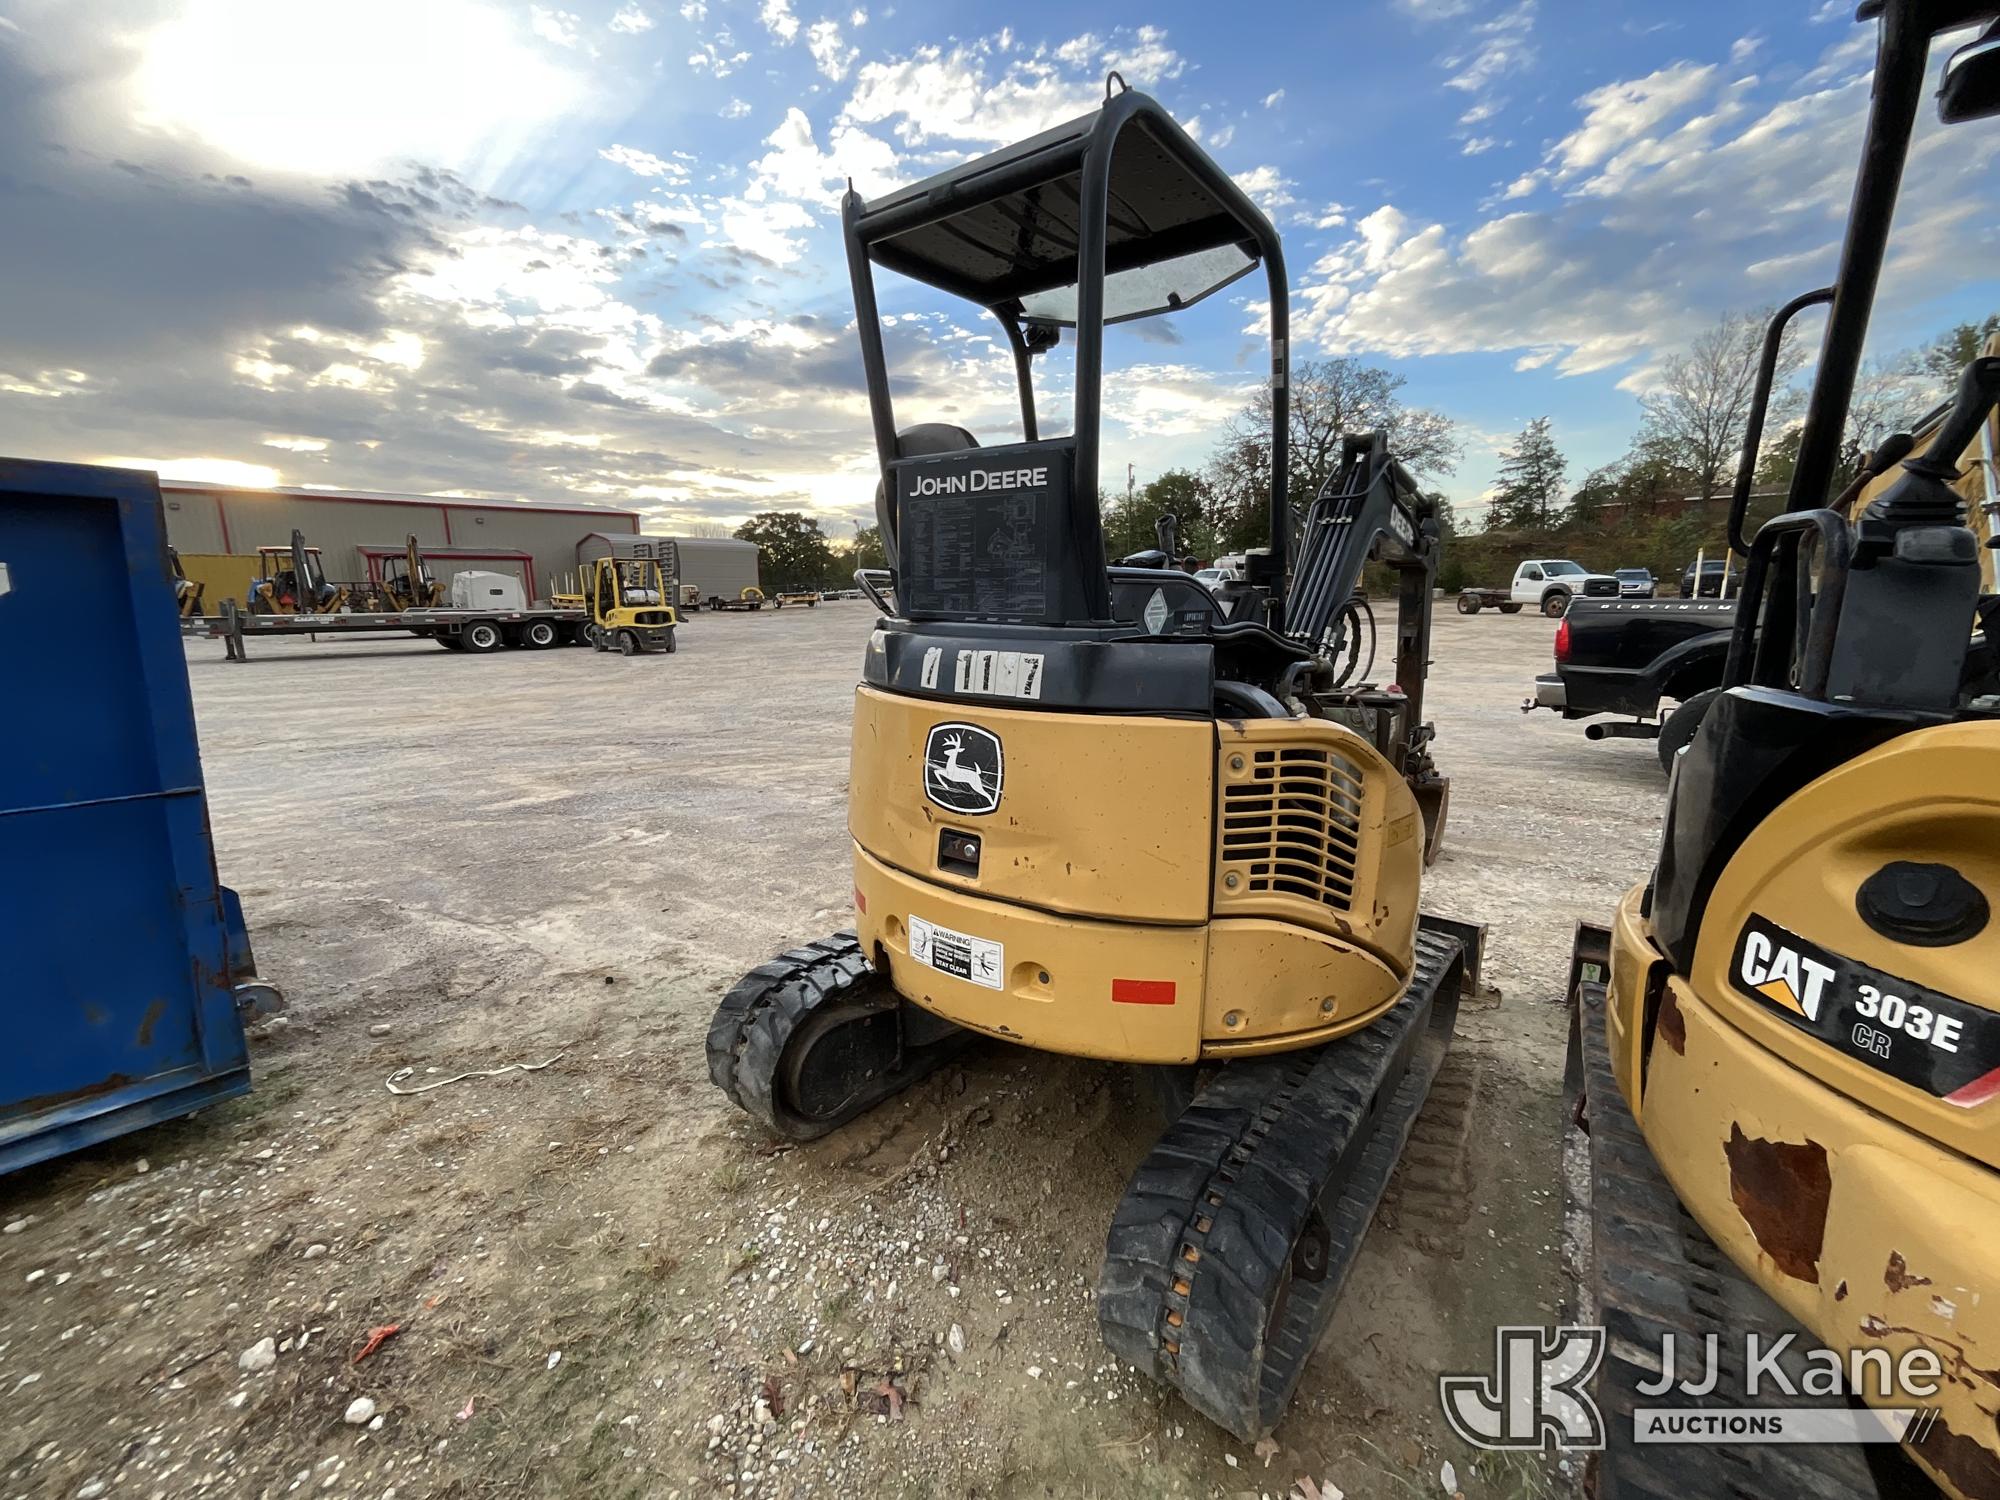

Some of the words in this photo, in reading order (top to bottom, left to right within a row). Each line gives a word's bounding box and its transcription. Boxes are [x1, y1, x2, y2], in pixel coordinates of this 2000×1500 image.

[909, 475, 967, 497] JOHN
[970, 467, 1048, 492] DEERE
[939, 931, 971, 946] WARNING
[950, 963, 967, 975] CLEAR
[1741, 931, 1836, 1022] CAT
[1854, 984, 1964, 1054] 303E
[1851, 1022, 1892, 1059] CR
